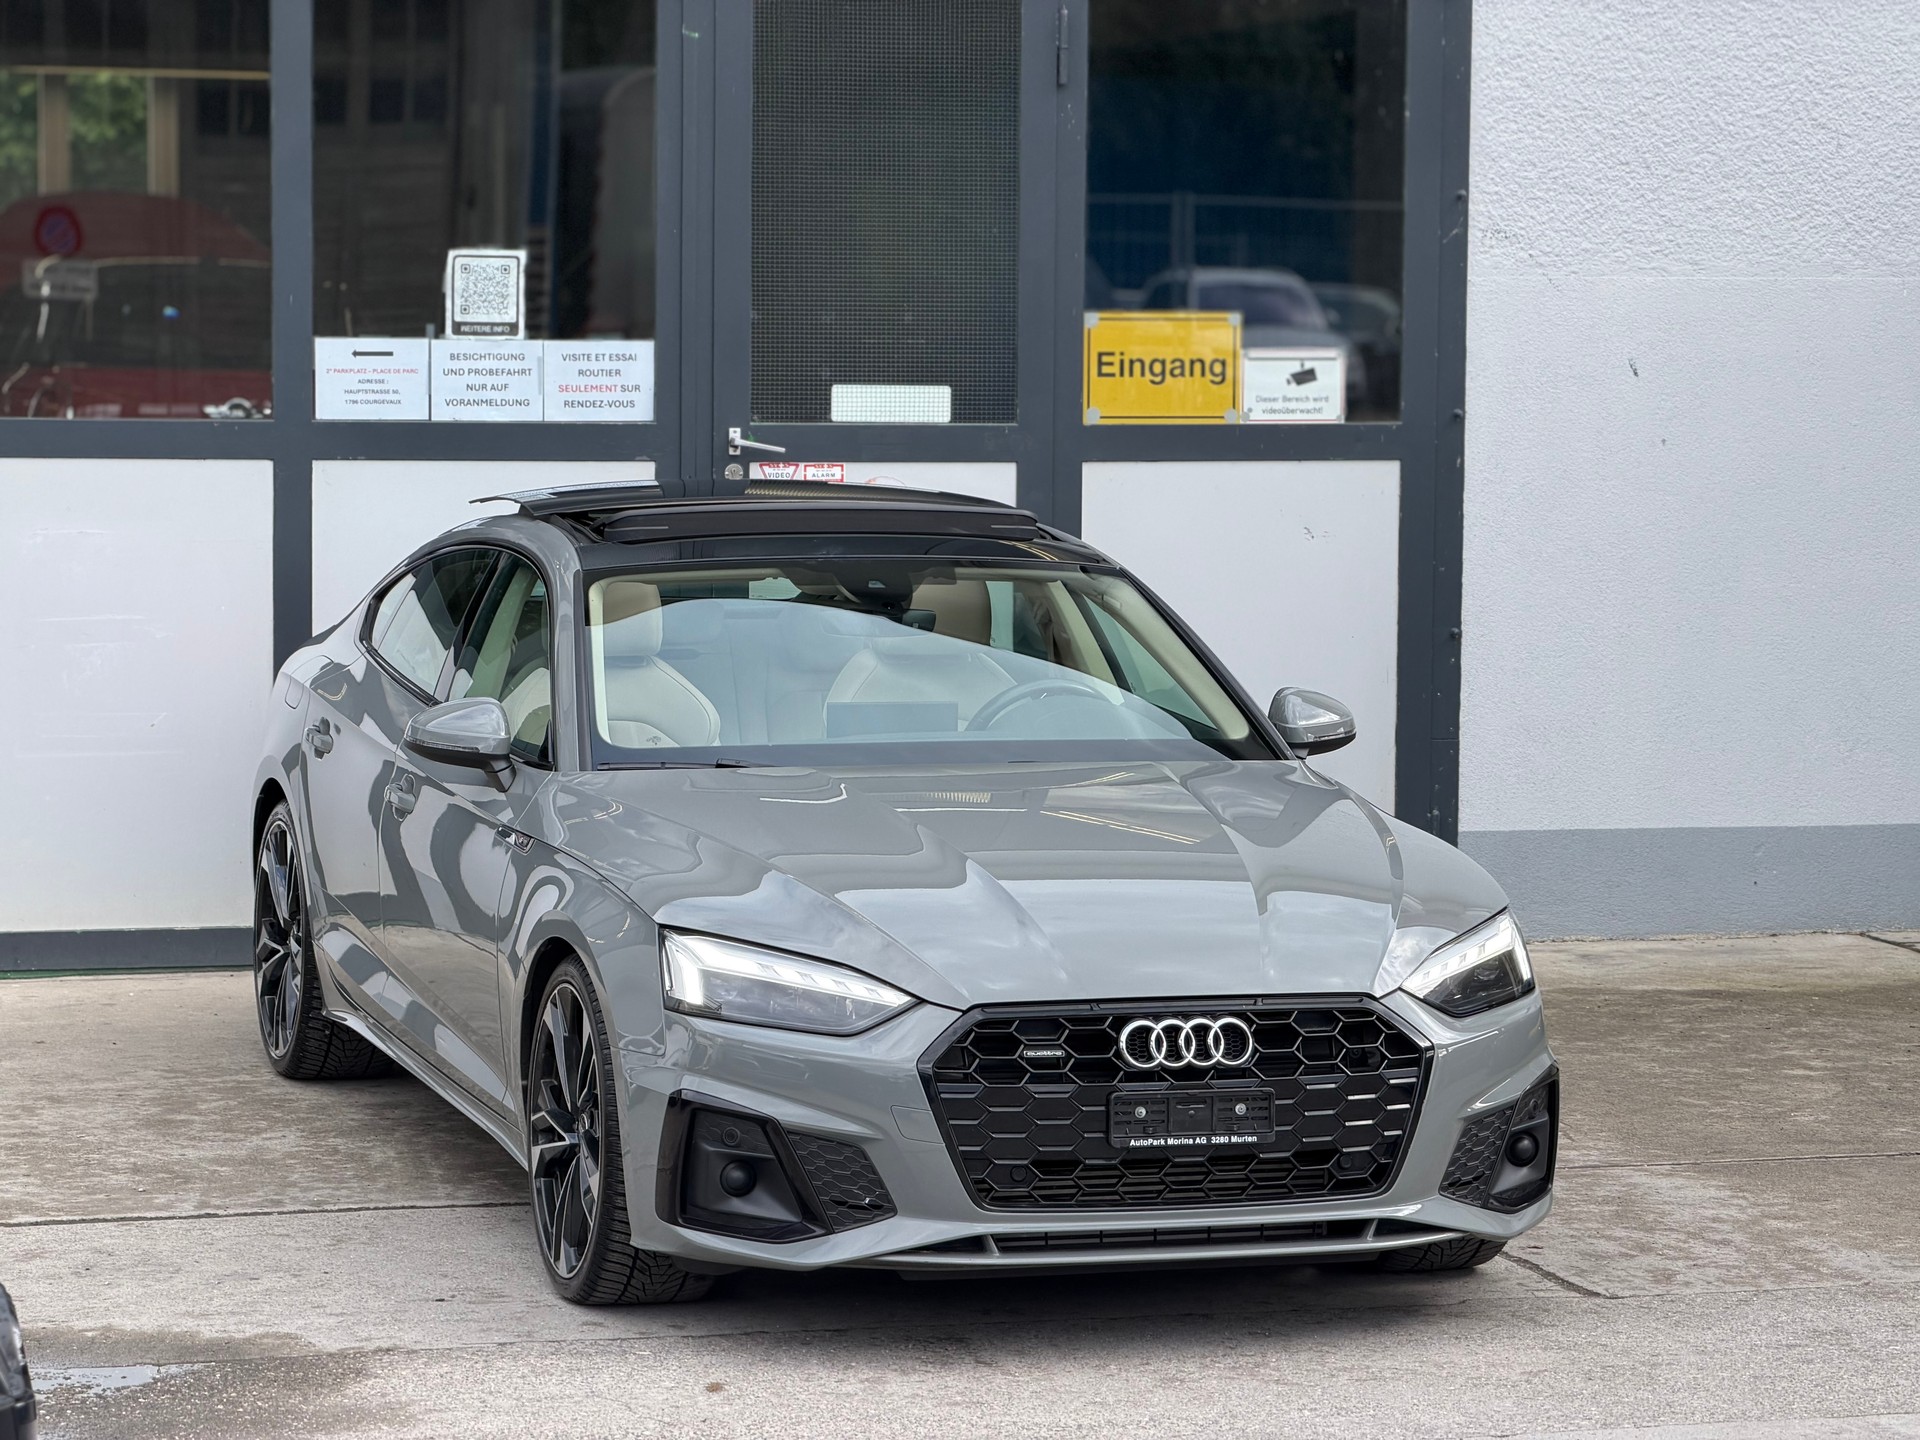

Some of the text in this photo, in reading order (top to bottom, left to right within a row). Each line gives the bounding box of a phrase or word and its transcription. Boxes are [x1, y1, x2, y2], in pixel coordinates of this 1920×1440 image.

[460, 325, 510, 333] WEITERE INFO
[449, 352, 526, 362] BESICHTIGUNG
[561, 353, 637, 362] VISITE ET ESSAI
[442, 367, 533, 377] UND PROBEFAHRT
[577, 368, 622, 378] ROUTIER
[1096, 351, 1228, 386] Eingang
[465, 383, 510, 392] NUR AUF
[558, 384, 641, 393] SEULEMENT SUR
[444, 398, 531, 407] VORANMELDUNG
[1255, 395, 1330, 403] Dieser Bereich wird
[563, 399, 636, 409] RENDEZ-VOUS
[1261, 406, 1324, 415] videoüberwacht!
[1129, 1137, 1166, 1147] AutoPark
[1167, 1136, 1194, 1145] Morina
[1210, 1136, 1230, 1144] 3280
[1230, 1135, 1258, 1143] Murten
